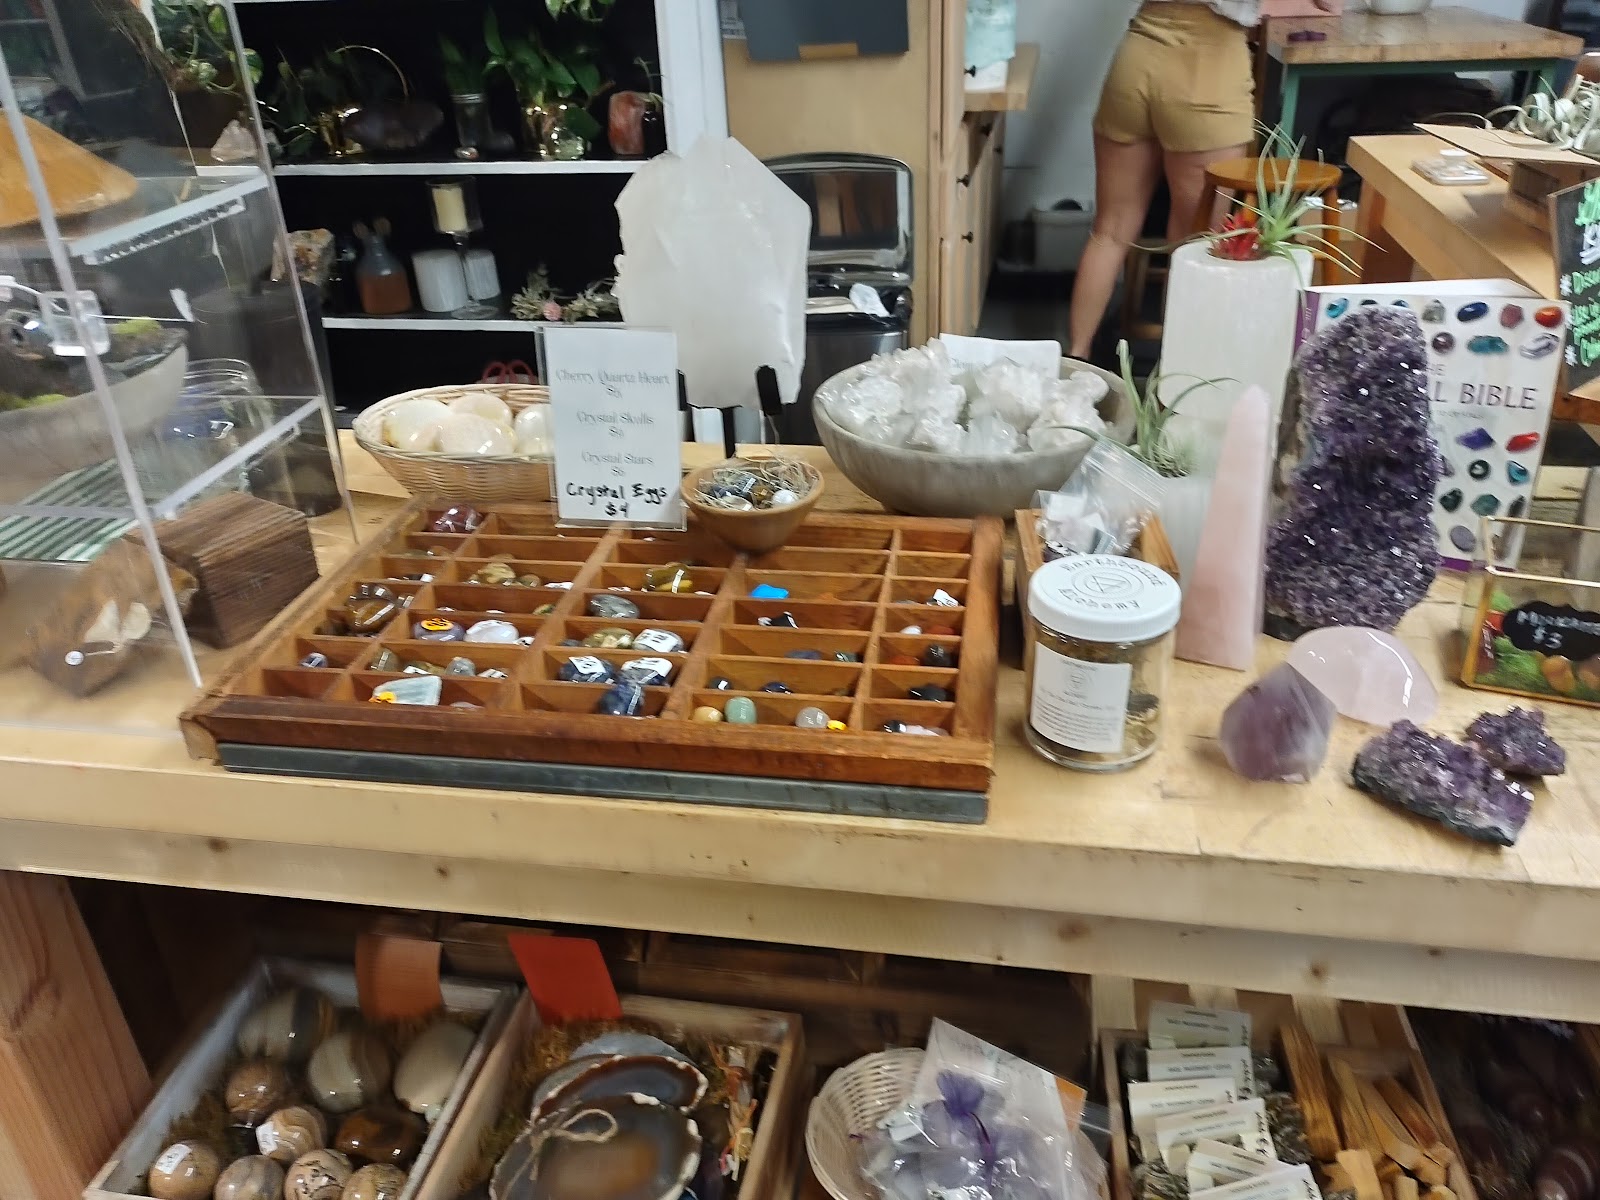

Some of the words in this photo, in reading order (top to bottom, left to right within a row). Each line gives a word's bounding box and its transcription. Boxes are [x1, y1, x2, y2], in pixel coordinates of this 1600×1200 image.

[555, 368, 595, 384] Cherry
[597, 369, 636, 386] Quartz
[638, 370, 670, 385] Heart
[1459, 382, 1539, 410] BIBLE
[577, 410, 617, 426] Crystal
[620, 412, 655, 425] Skulls
[582, 450, 622, 466] Crystal
[625, 452, 655, 466] Stars
[566, 481, 627, 506] Crystal
[631, 482, 668, 506] Eggs
[604, 502, 630, 519] $4
